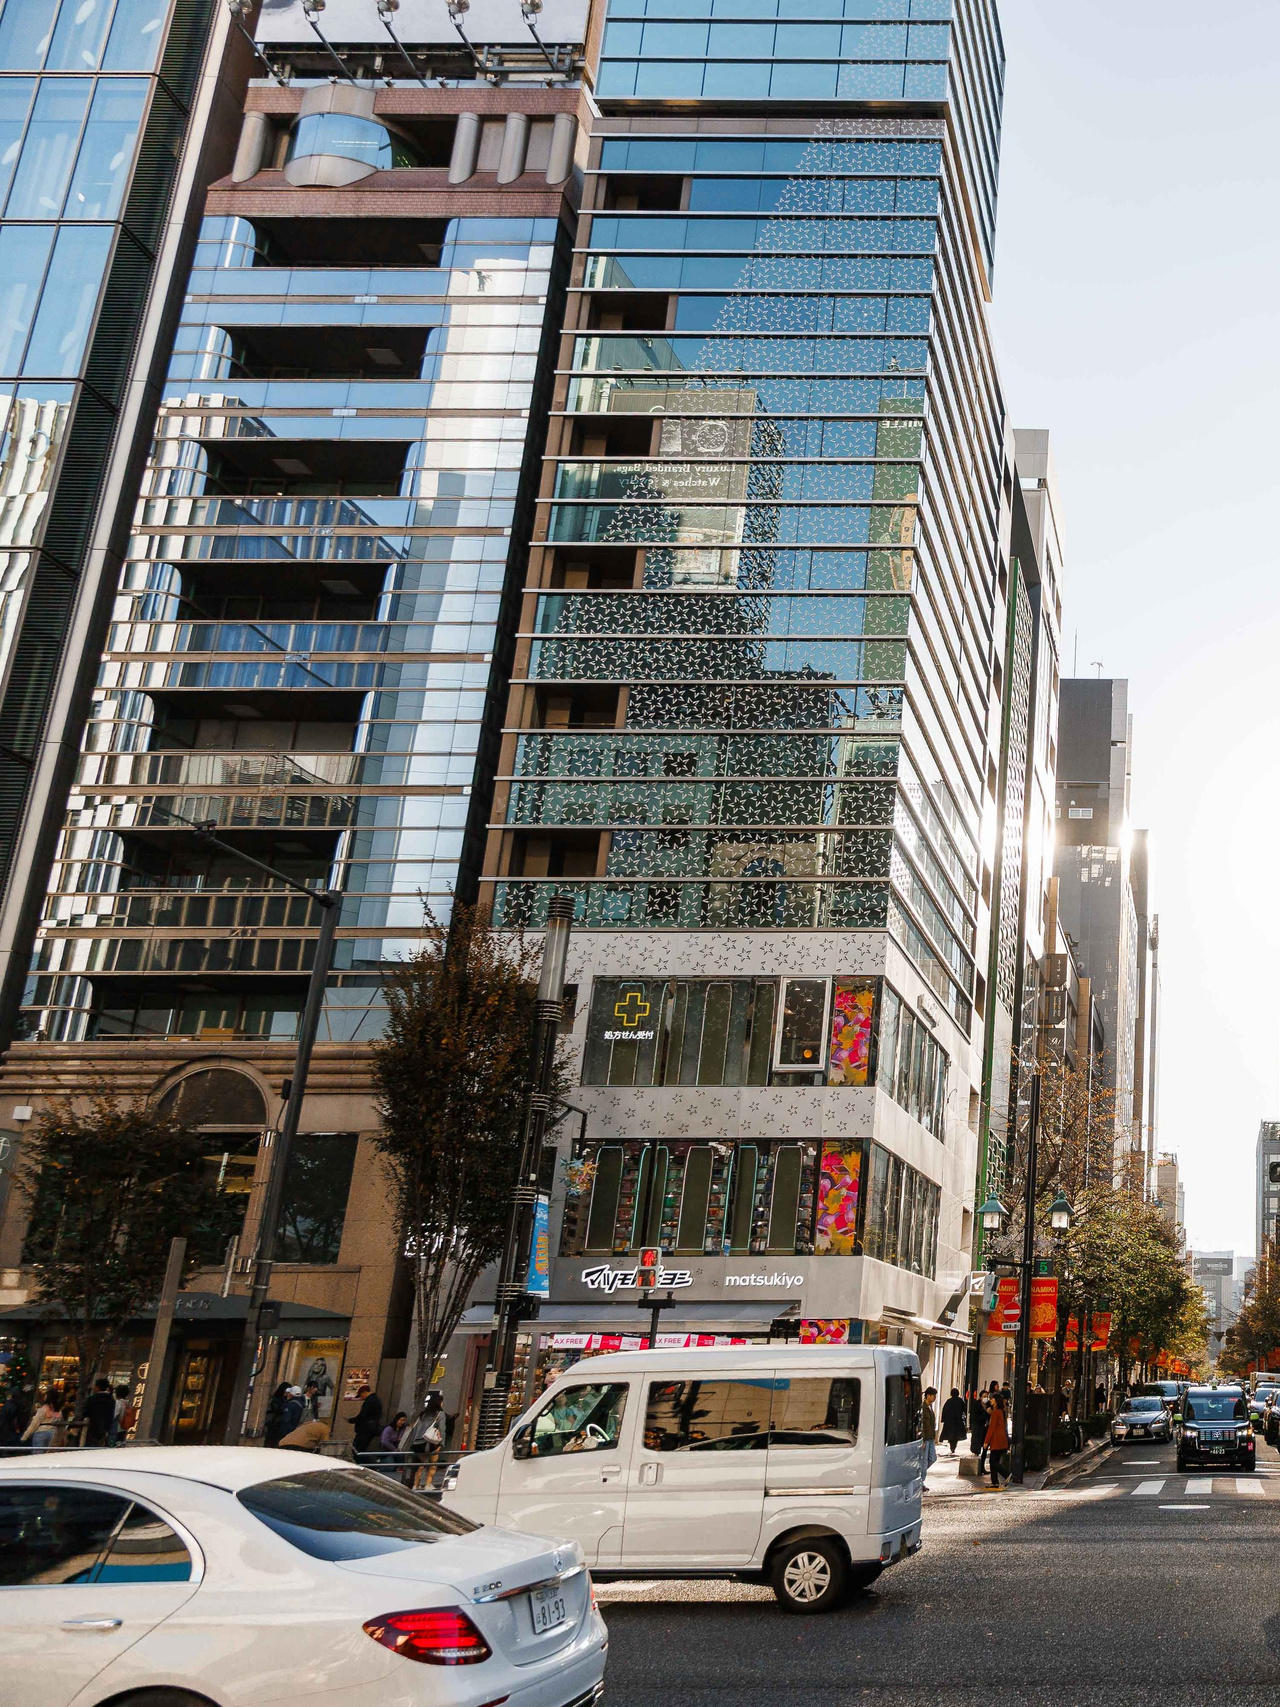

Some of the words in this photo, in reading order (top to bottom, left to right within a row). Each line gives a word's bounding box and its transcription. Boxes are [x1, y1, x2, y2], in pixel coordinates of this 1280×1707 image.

[604, 1031, 654, 1040] 処方せん受付
[1040, 1261, 1048, 1272] 5
[725, 1272, 804, 1289] matsukiyo
[541, 1598, 566, 1626] 81-93
